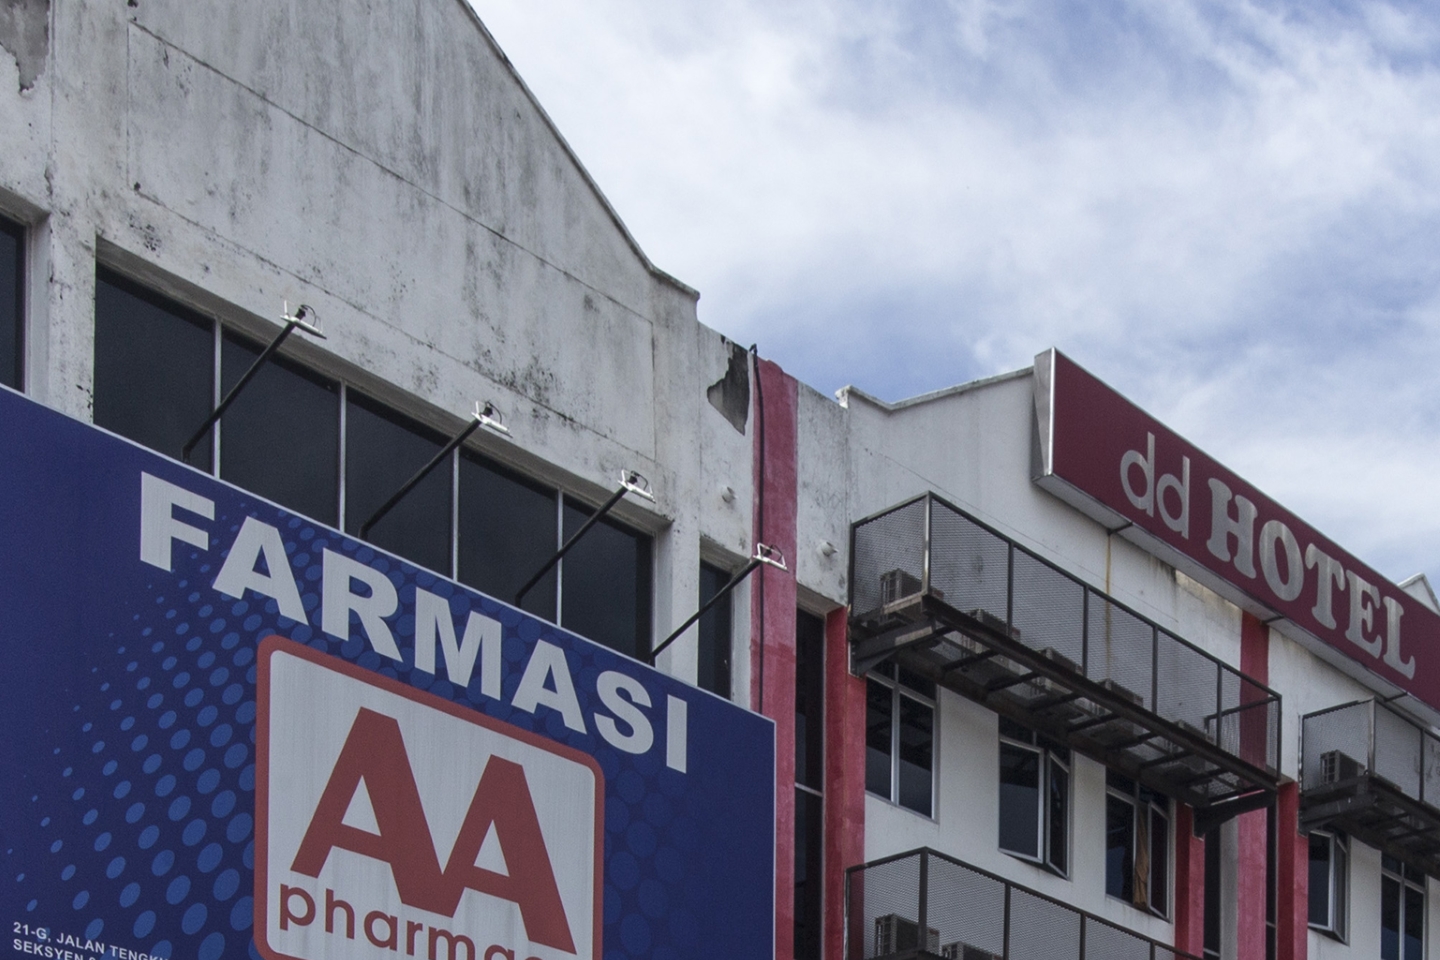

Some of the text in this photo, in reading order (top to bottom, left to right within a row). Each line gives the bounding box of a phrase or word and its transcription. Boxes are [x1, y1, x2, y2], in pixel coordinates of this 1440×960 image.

[140, 470, 688, 774] FARMASI
[1120, 432, 1416, 681] dd HOTEL
[13, 921, 51, 944] 21-G,
[56, 932, 105, 954] JALAN
[290, 706, 577, 955] AA
